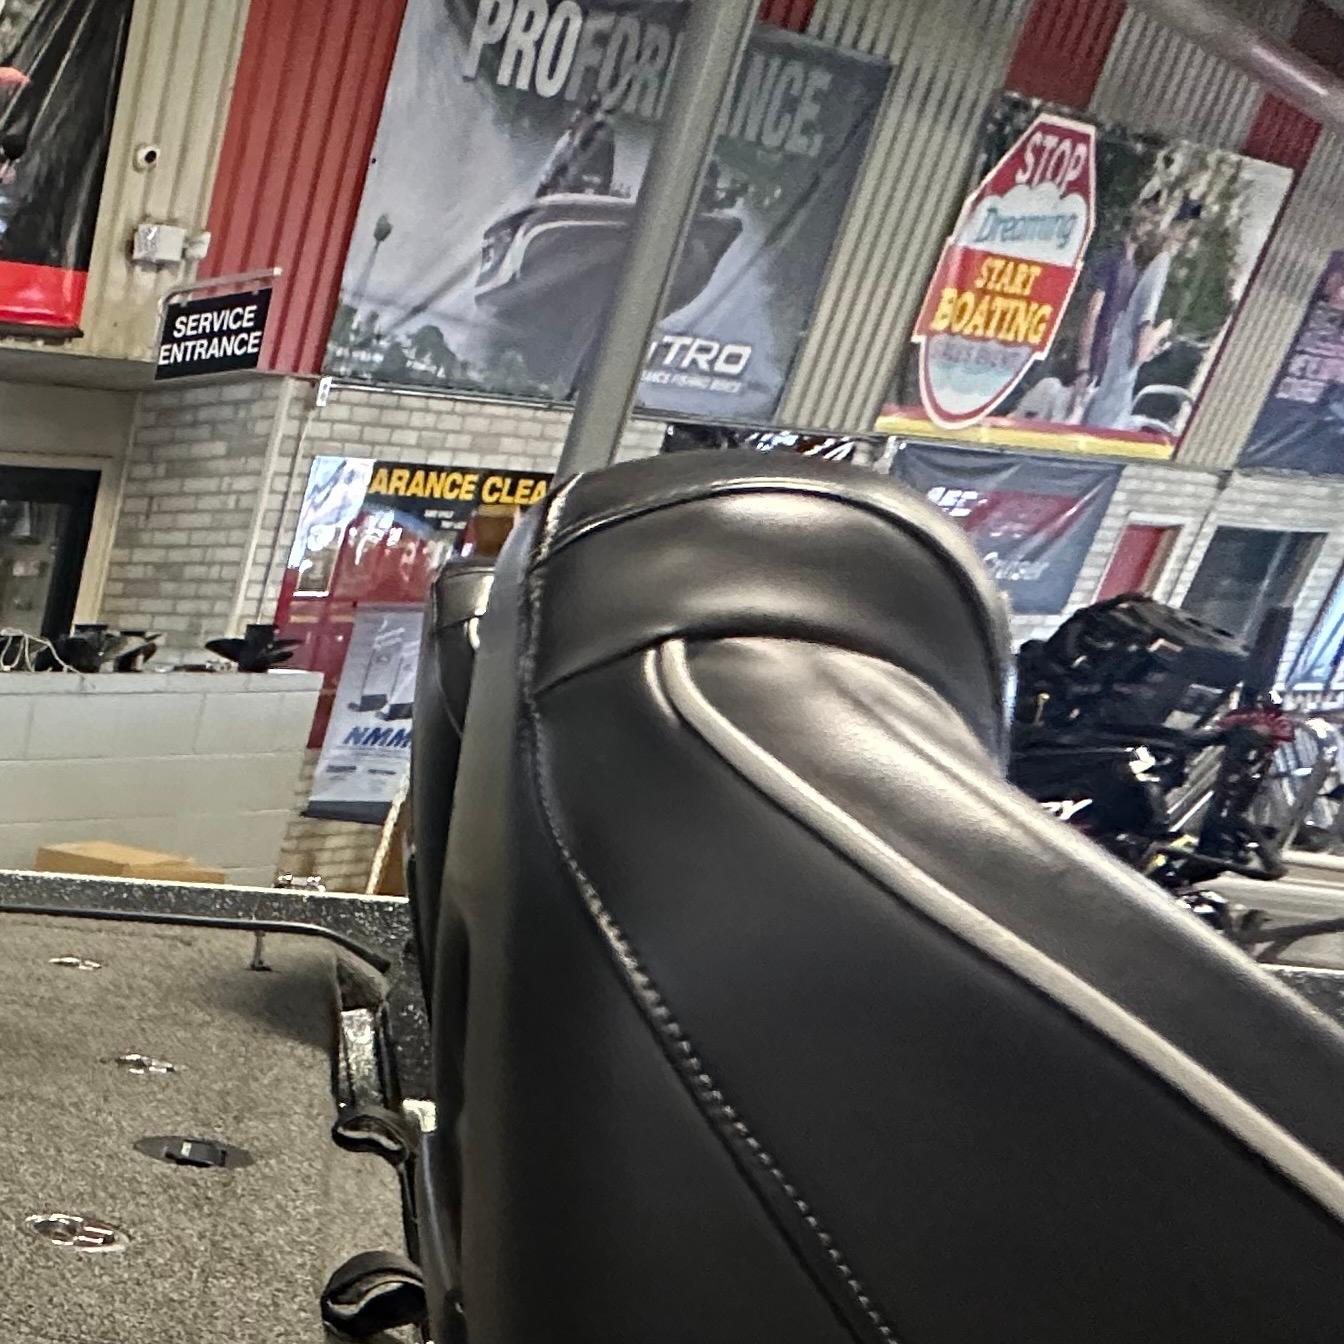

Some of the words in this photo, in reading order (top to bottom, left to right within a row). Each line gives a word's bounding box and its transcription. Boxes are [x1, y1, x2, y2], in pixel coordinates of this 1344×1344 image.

[1015, 131, 1088, 190] STOP
[975, 255, 1042, 296] START
[172, 305, 258, 338] SERVICE
[929, 287, 1054, 345] BOATING
[158, 331, 262, 365] ENTRANCE
[368, 468, 479, 501] ARANCE
[480, 475, 548, 505] CLEA
